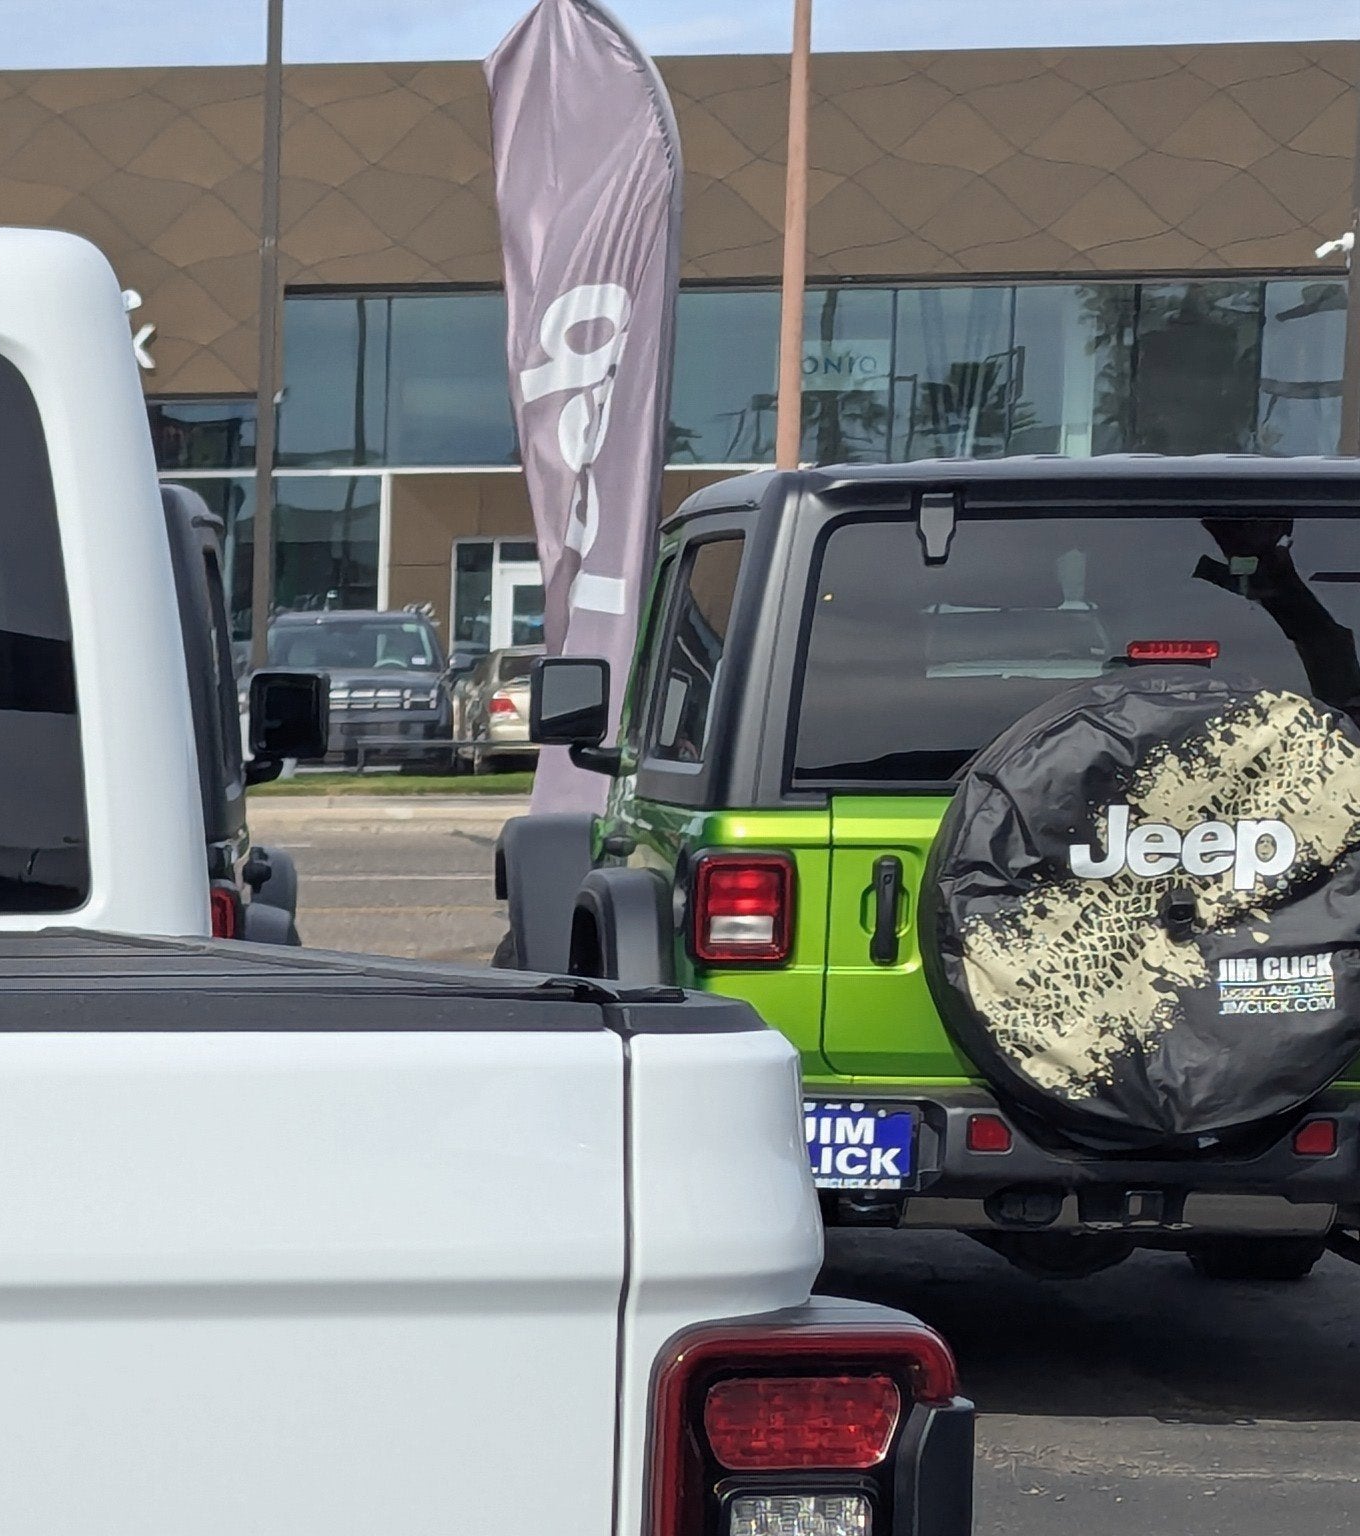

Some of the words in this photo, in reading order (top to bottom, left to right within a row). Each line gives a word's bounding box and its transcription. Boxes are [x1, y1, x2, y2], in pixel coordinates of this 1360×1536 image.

[1068, 804, 1298, 890] Jeep
[1218, 957, 1258, 982] JIM
[1262, 952, 1335, 980] CLICK
[805, 1116, 876, 1145] JIM
[811, 1146, 901, 1176] ICK
